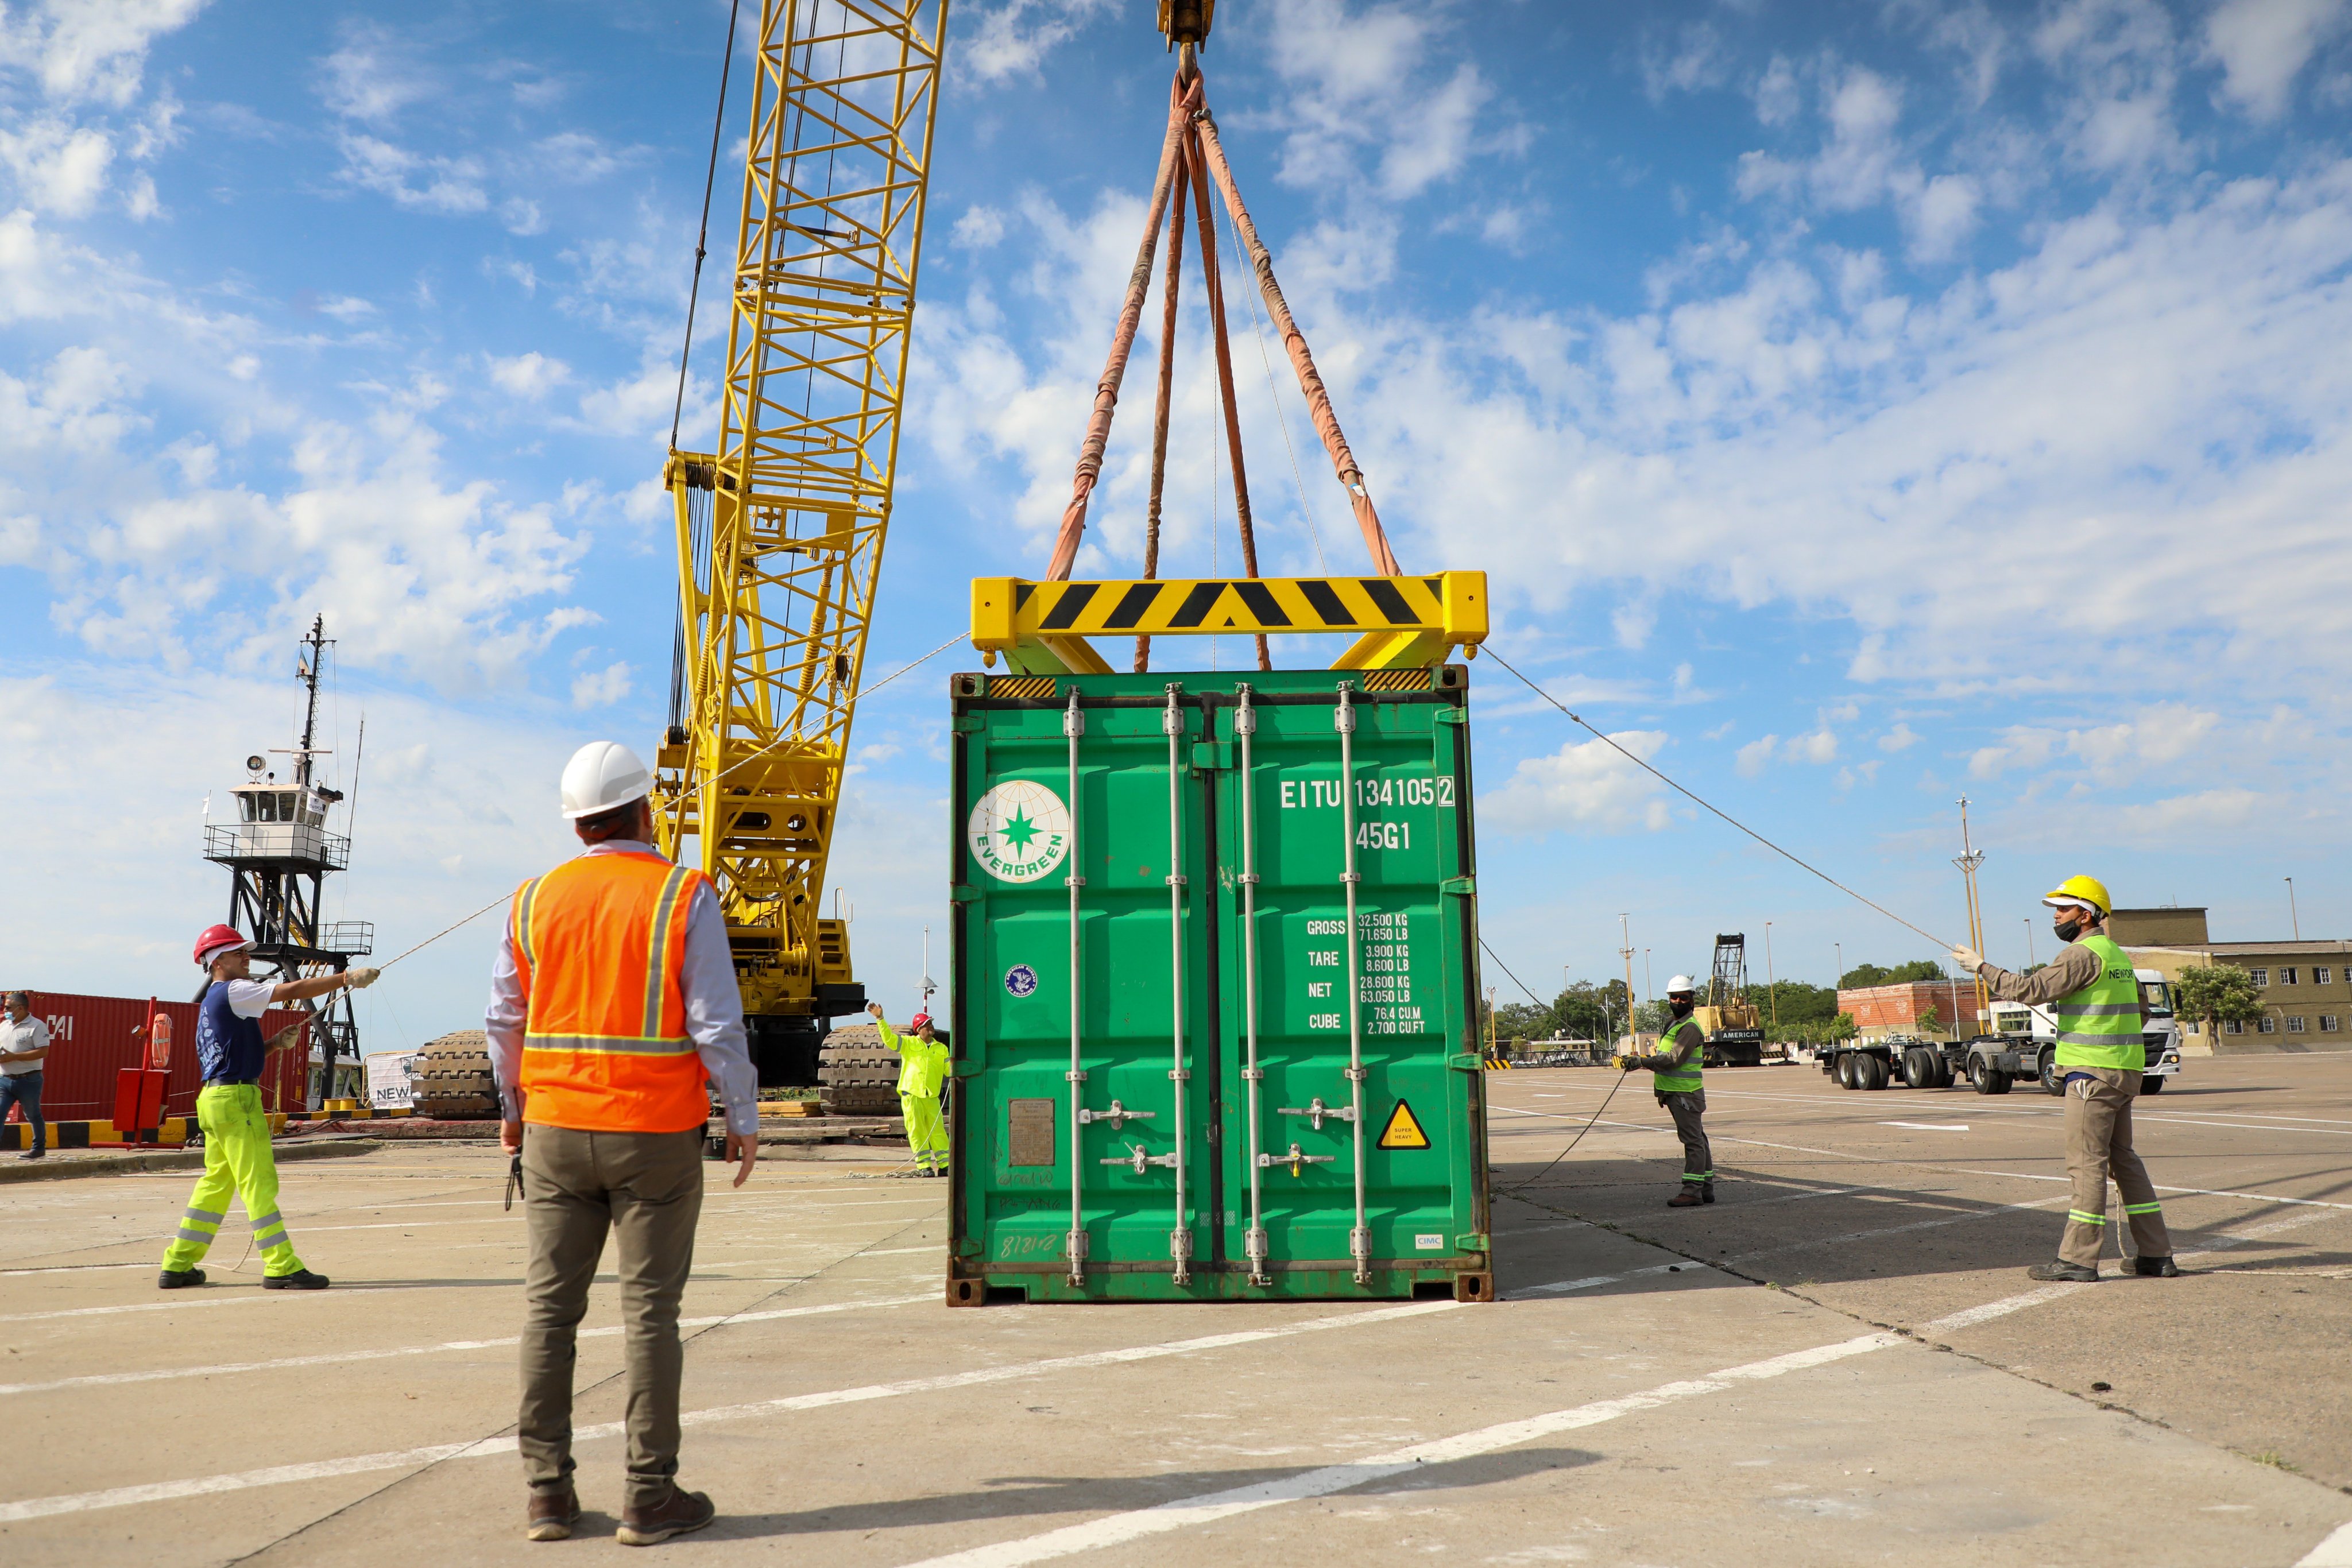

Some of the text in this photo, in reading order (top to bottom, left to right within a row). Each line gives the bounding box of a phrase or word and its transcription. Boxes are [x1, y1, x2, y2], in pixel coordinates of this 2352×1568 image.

[1281, 780, 1341, 808] EITU
[1356, 823, 1409, 849] 45G1
[977, 834, 1062, 876] EVERGREEN
[1307, 914, 1407, 935] GROSS 32.500 KG
[1359, 928, 1408, 940] 71.650 LB
[1308, 944, 1409, 966] TARE 3.900 KG
[1366, 959, 1409, 971] 8.600 LB
[1006, 966, 1036, 982] AMERICAN BUREAU
[1013, 988, 1033, 996] SHIPPING
[1309, 975, 1410, 997] NET 28.600 KG
[1360, 990, 1410, 1003] 63.050 LB
[47, 1015, 74, 1040] CAI
[1309, 1006, 1421, 1029] CUBE 76.4 CU.M
[1368, 1021, 1425, 1034] 2.700 CU.FT
